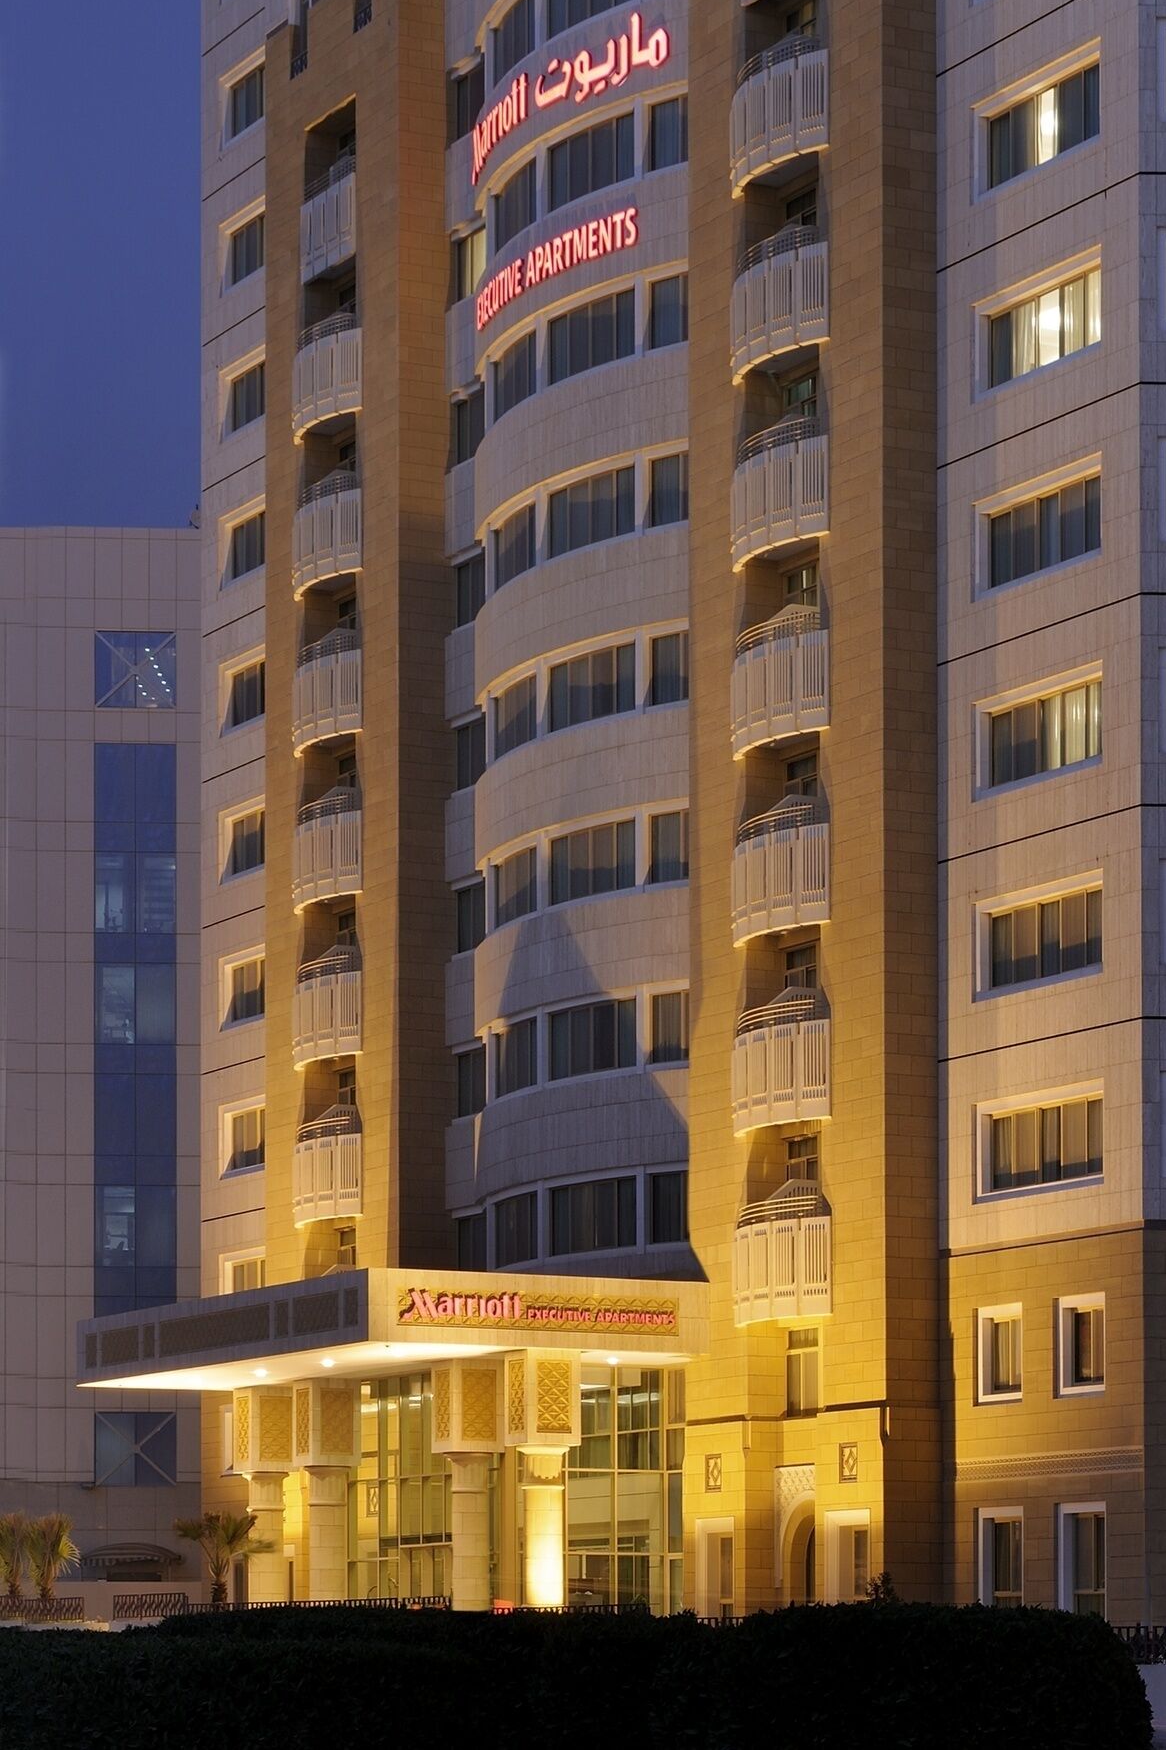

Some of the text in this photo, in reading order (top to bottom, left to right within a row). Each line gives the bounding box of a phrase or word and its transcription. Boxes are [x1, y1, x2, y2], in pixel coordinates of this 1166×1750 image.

[535, 12, 670, 108] ماريوت
[471, 72, 528, 186] Marriott
[475, 207, 638, 331] EXECUTIVE APARTMENTS
[400, 1287, 676, 1326] Marriott EXECUTIVE APARTMENTS
